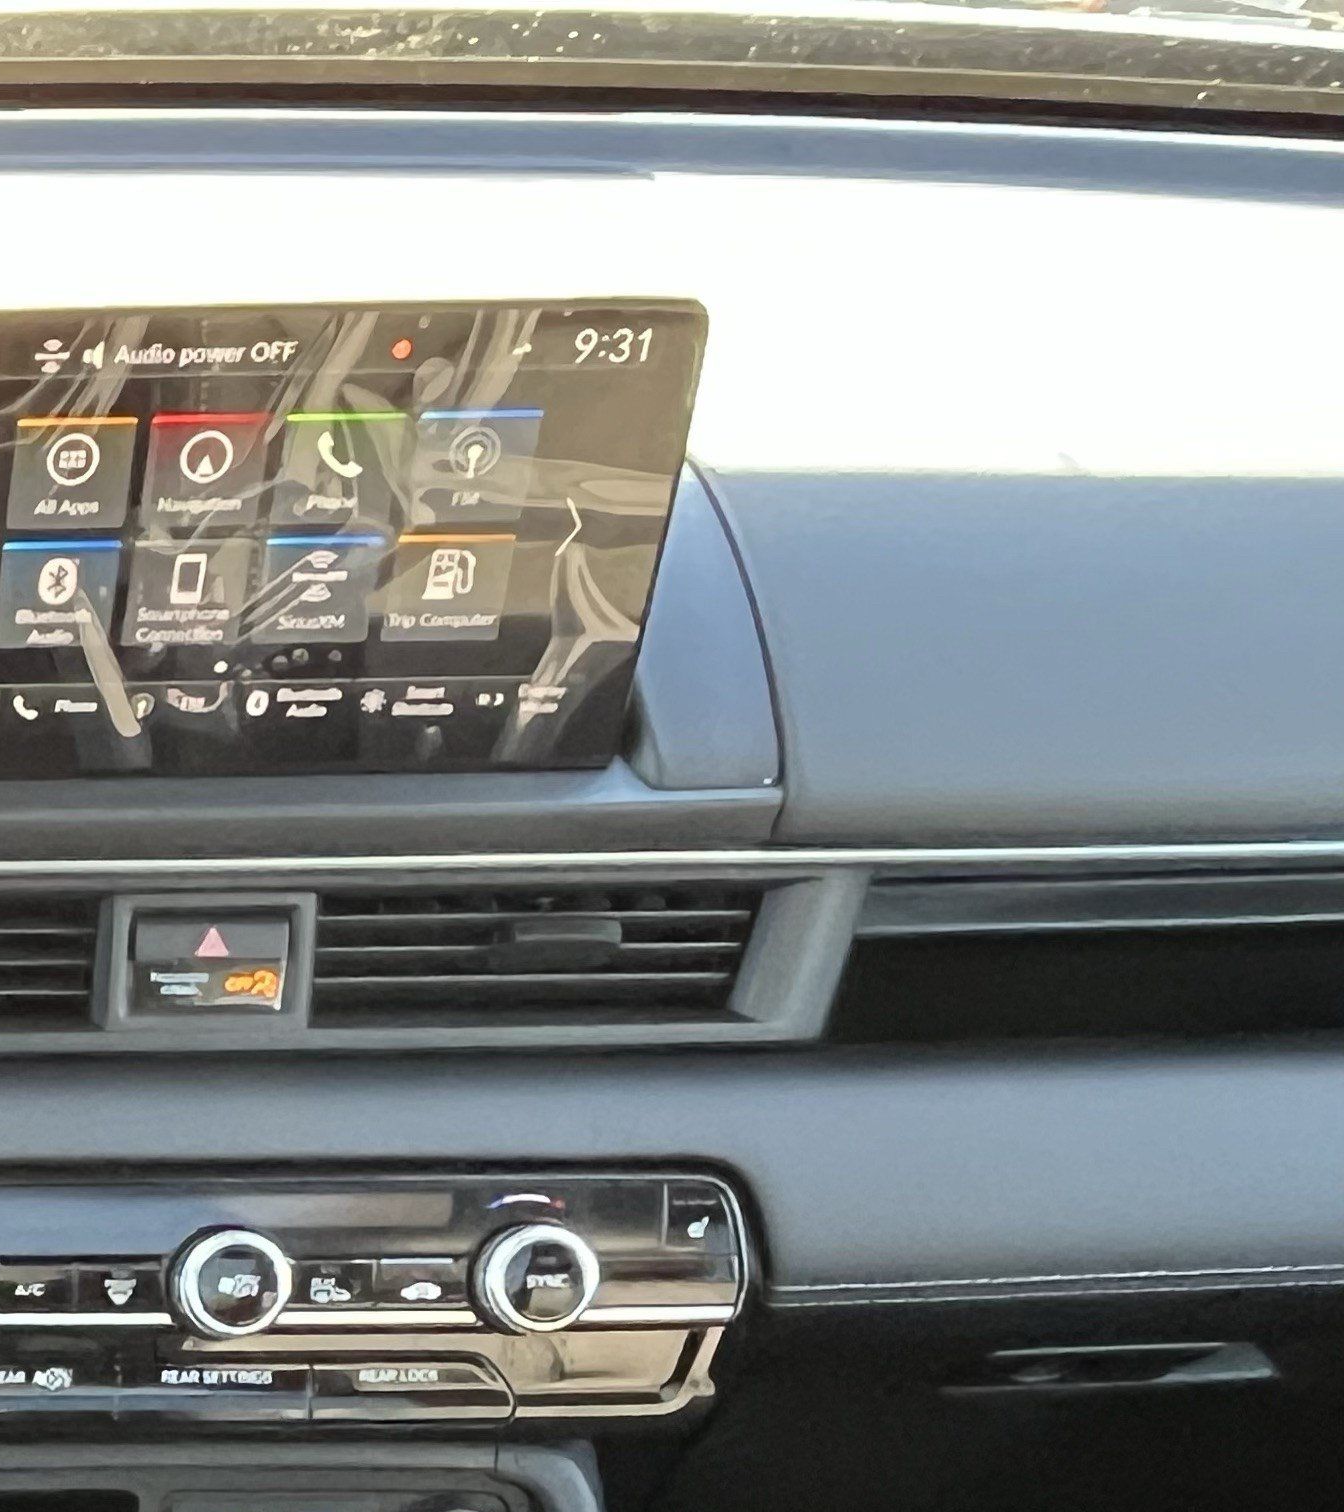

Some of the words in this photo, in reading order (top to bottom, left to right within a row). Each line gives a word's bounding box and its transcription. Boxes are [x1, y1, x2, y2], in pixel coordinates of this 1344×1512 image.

[575, 327, 654, 364] 9:31
[114, 342, 176, 365] Audio
[178, 347, 247, 368] power
[250, 340, 299, 363] OFF
[388, 613, 416, 629] Trip
[419, 613, 498, 629] Computer
[14, 1283, 46, 1297] A/C
[161, 1369, 200, 1385] REAR
[358, 1368, 396, 1383] REAR
